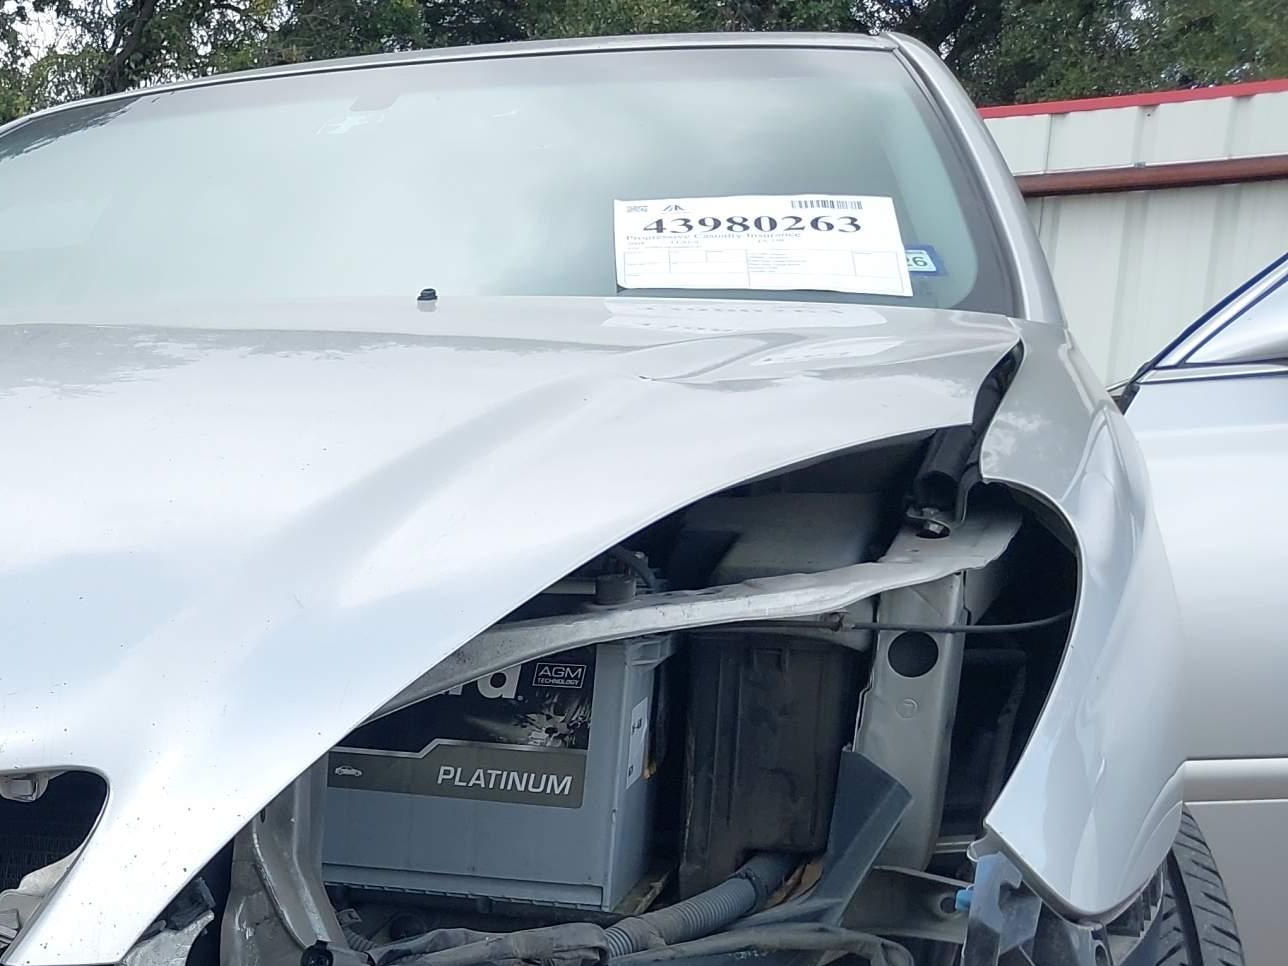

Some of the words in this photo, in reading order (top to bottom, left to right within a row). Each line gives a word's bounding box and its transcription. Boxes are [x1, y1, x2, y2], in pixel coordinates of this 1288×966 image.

[643, 215, 863, 234] 43980263
[538, 666, 582, 679] AGM
[537, 677, 580, 686] TECHNOLOGY
[437, 766, 574, 796] PLATINUM
